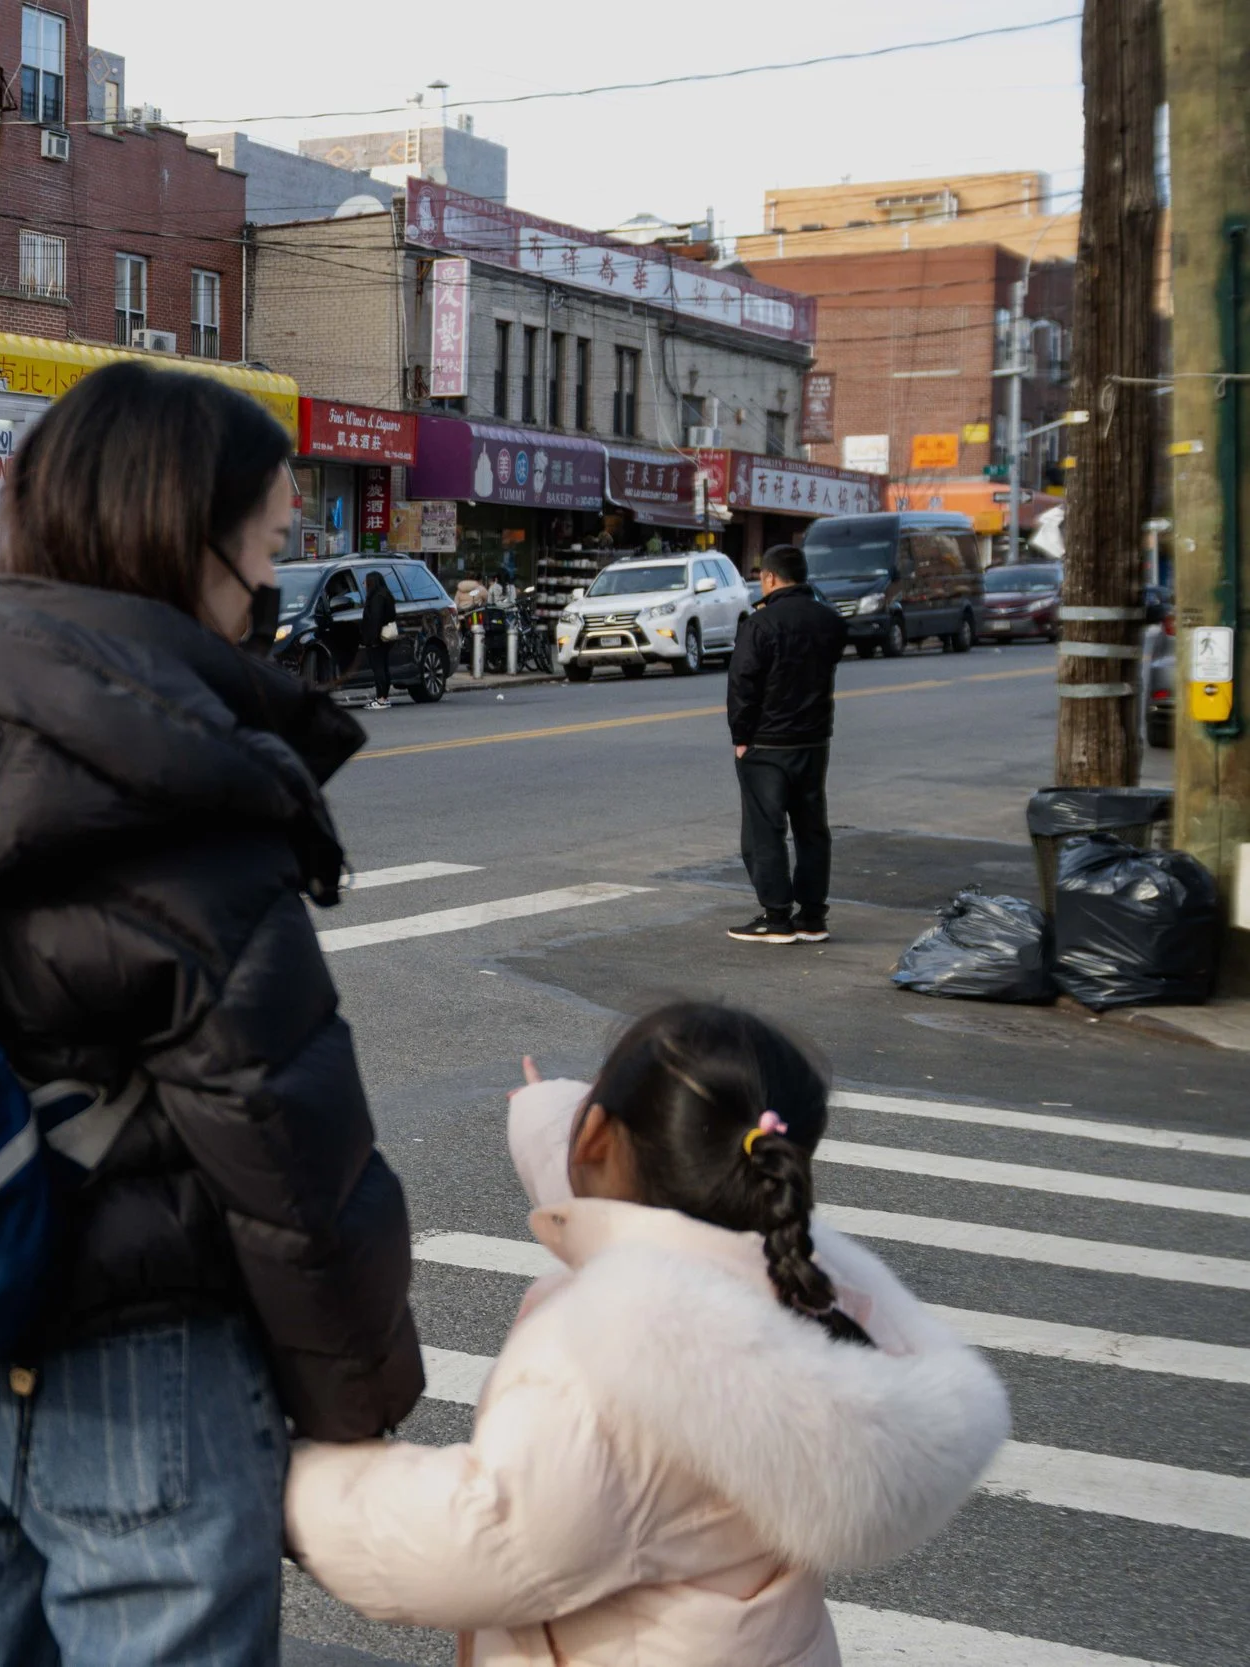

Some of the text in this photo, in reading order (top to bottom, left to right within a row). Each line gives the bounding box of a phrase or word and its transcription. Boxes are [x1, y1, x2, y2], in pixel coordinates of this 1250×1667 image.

[329, 408, 344, 425] Fine
[345, 410, 366, 428] Wines
[375, 415, 400, 434] Liquors
[499, 488, 526, 501] YUMMY
[546, 492, 573, 505] BAKERY
